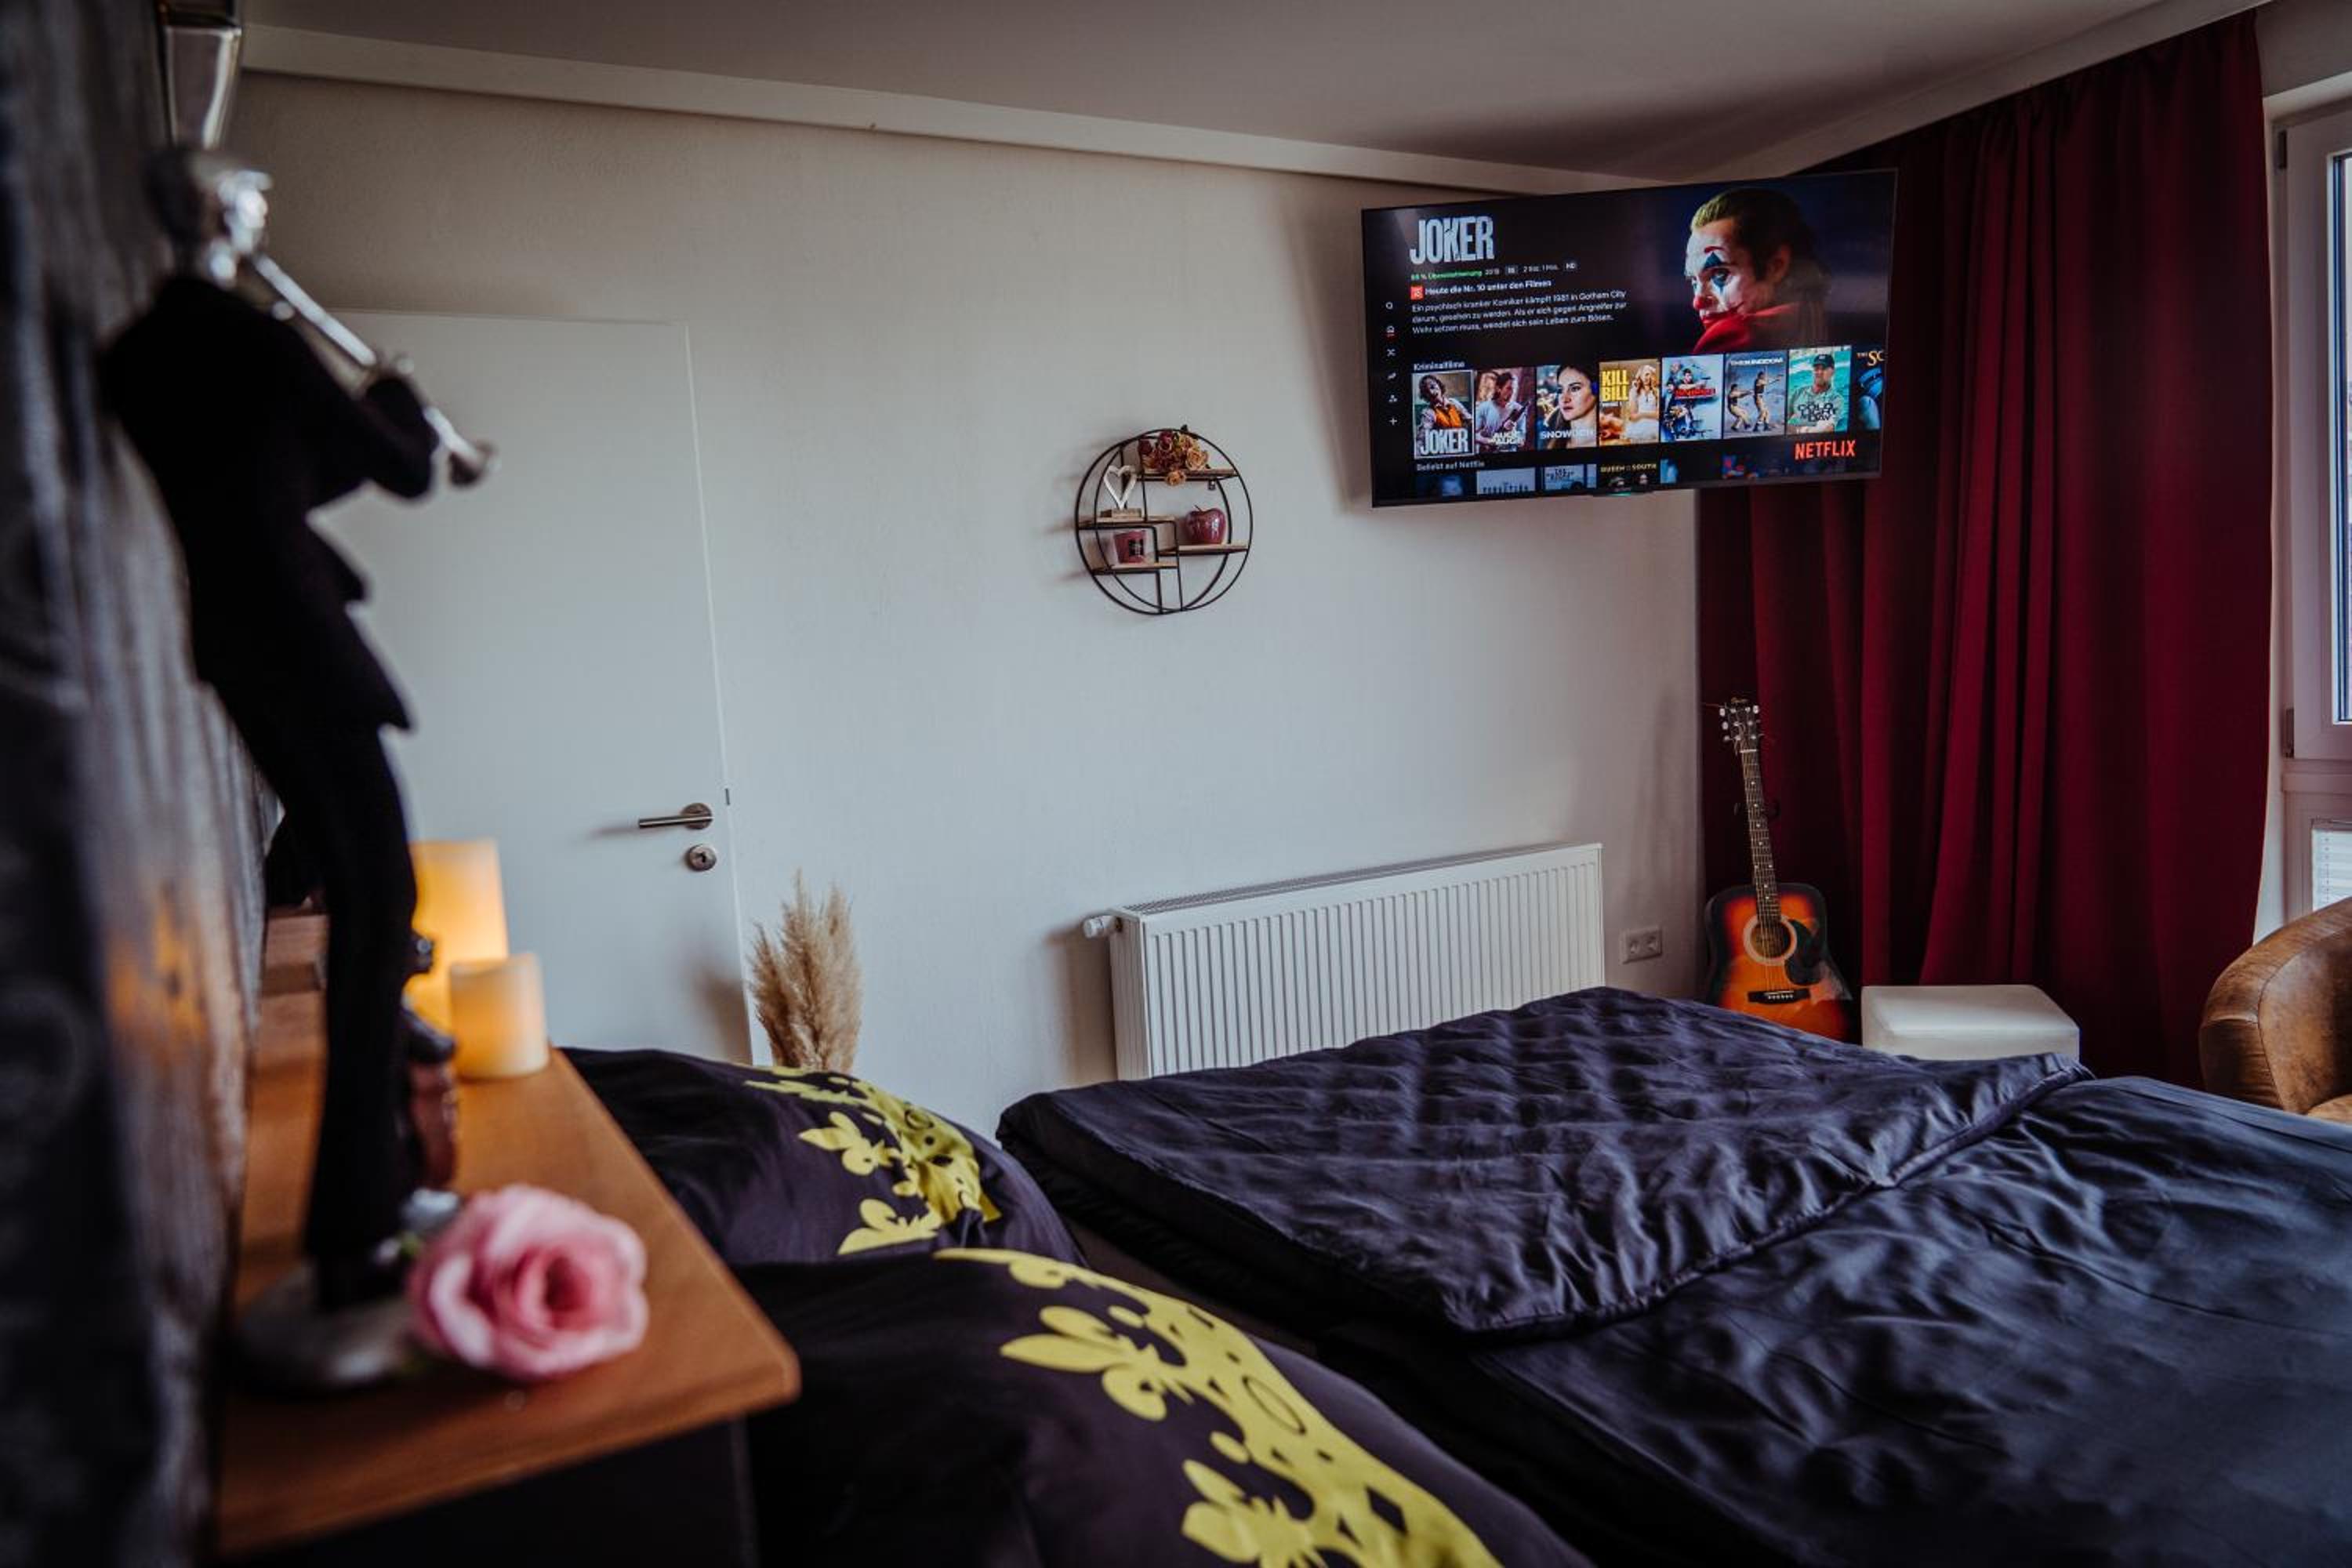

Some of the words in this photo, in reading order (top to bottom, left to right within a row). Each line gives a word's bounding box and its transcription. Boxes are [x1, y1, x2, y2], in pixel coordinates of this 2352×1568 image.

[1410, 216, 1494, 264] JOKER
[1450, 285, 1461, 293] die
[1487, 282, 1507, 291] unter
[1509, 281, 1524, 289] den
[1525, 279, 1552, 288] Filmen
[1412, 303, 1424, 313] Ein
[1425, 301, 1462, 313] psychisch
[1463, 299, 1491, 308] kranker
[1492, 297, 1523, 307] Komiker
[1570, 292, 1578, 301] in
[1579, 291, 1609, 300] Gotham
[1610, 289, 1627, 299] City
[1439, 313, 1470, 323] gesehen
[1536, 306, 1552, 314] sich
[1553, 305, 1577, 314] gegen
[1578, 302, 1613, 313] Angreifer
[1412, 325, 1432, 334] Wehr
[1434, 325, 1458, 333] setzen
[1512, 318, 1527, 327] sich
[1528, 318, 1544, 326] sein
[1545, 316, 1569, 325] Leben
[1570, 315, 1586, 324] zum
[1602, 369, 1629, 385] KILL
[1602, 384, 1629, 401] BILL
[1420, 428, 1469, 455] JOKER
[1795, 439, 1857, 460] NETFLIX
